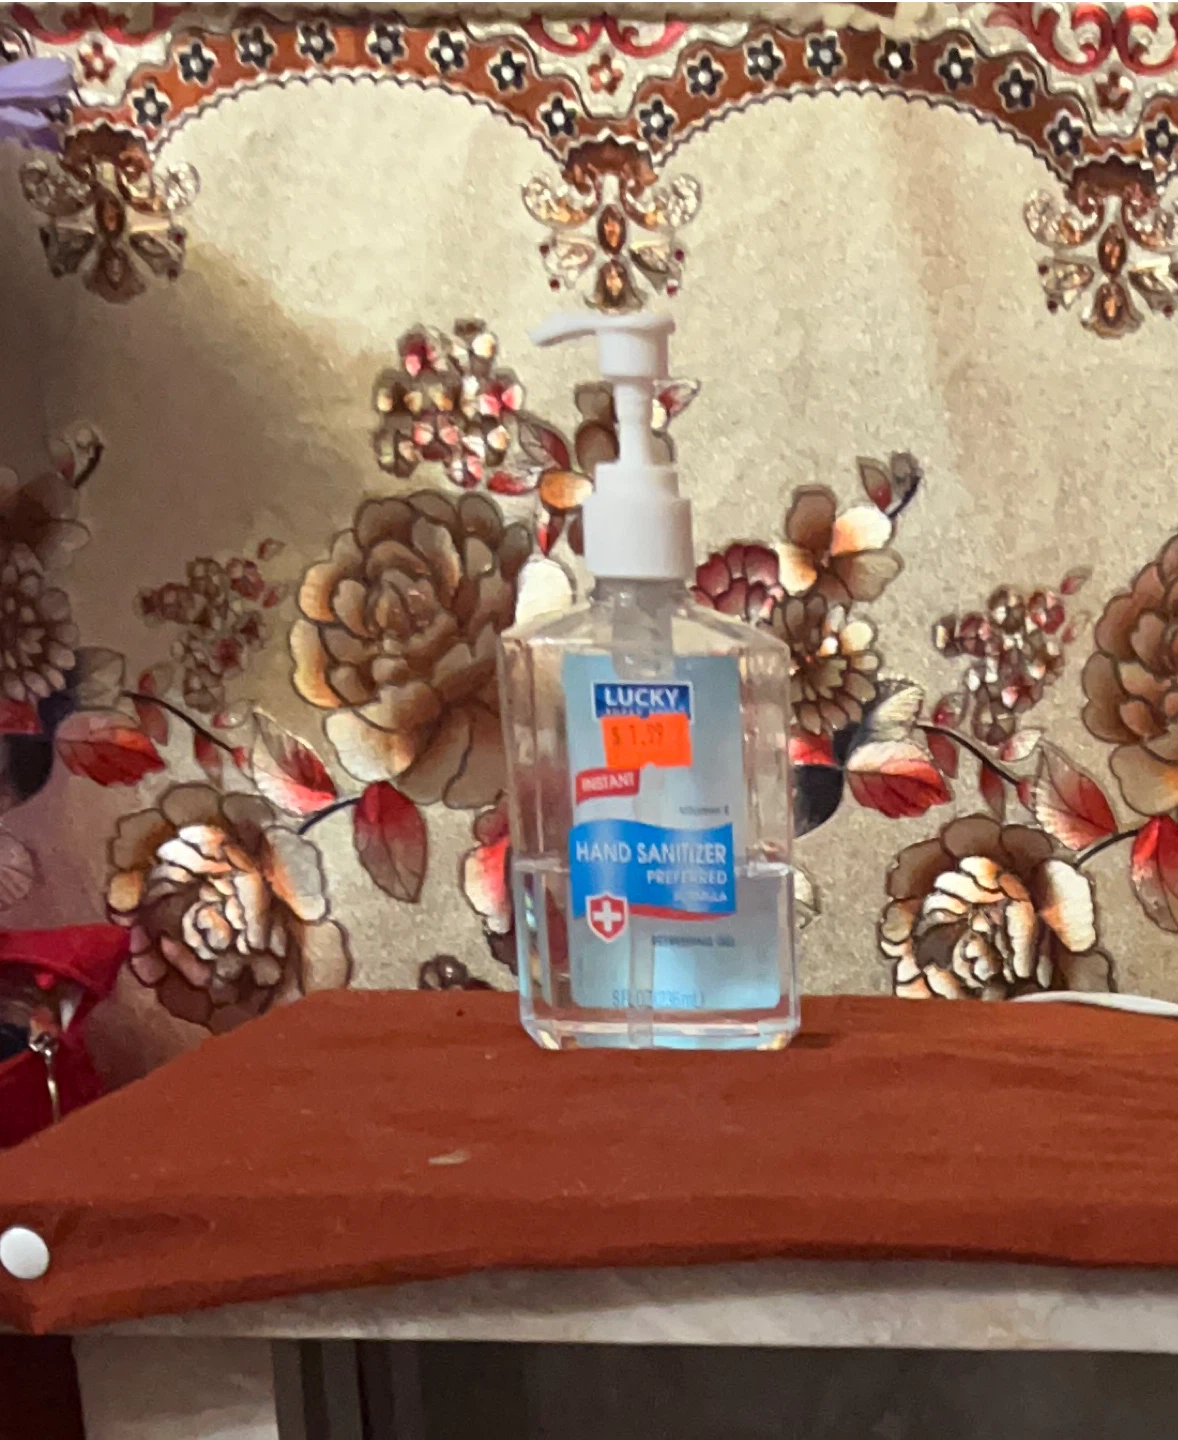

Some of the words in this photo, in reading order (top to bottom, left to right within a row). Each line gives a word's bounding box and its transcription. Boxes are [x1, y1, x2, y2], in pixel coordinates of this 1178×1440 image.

[605, 687, 679, 709] LUCKY
[581, 771, 635, 792] INSTANT
[576, 841, 632, 863] HAND
[637, 842, 727, 865] SANITIZER
[647, 869, 728, 885] PREFERRED
